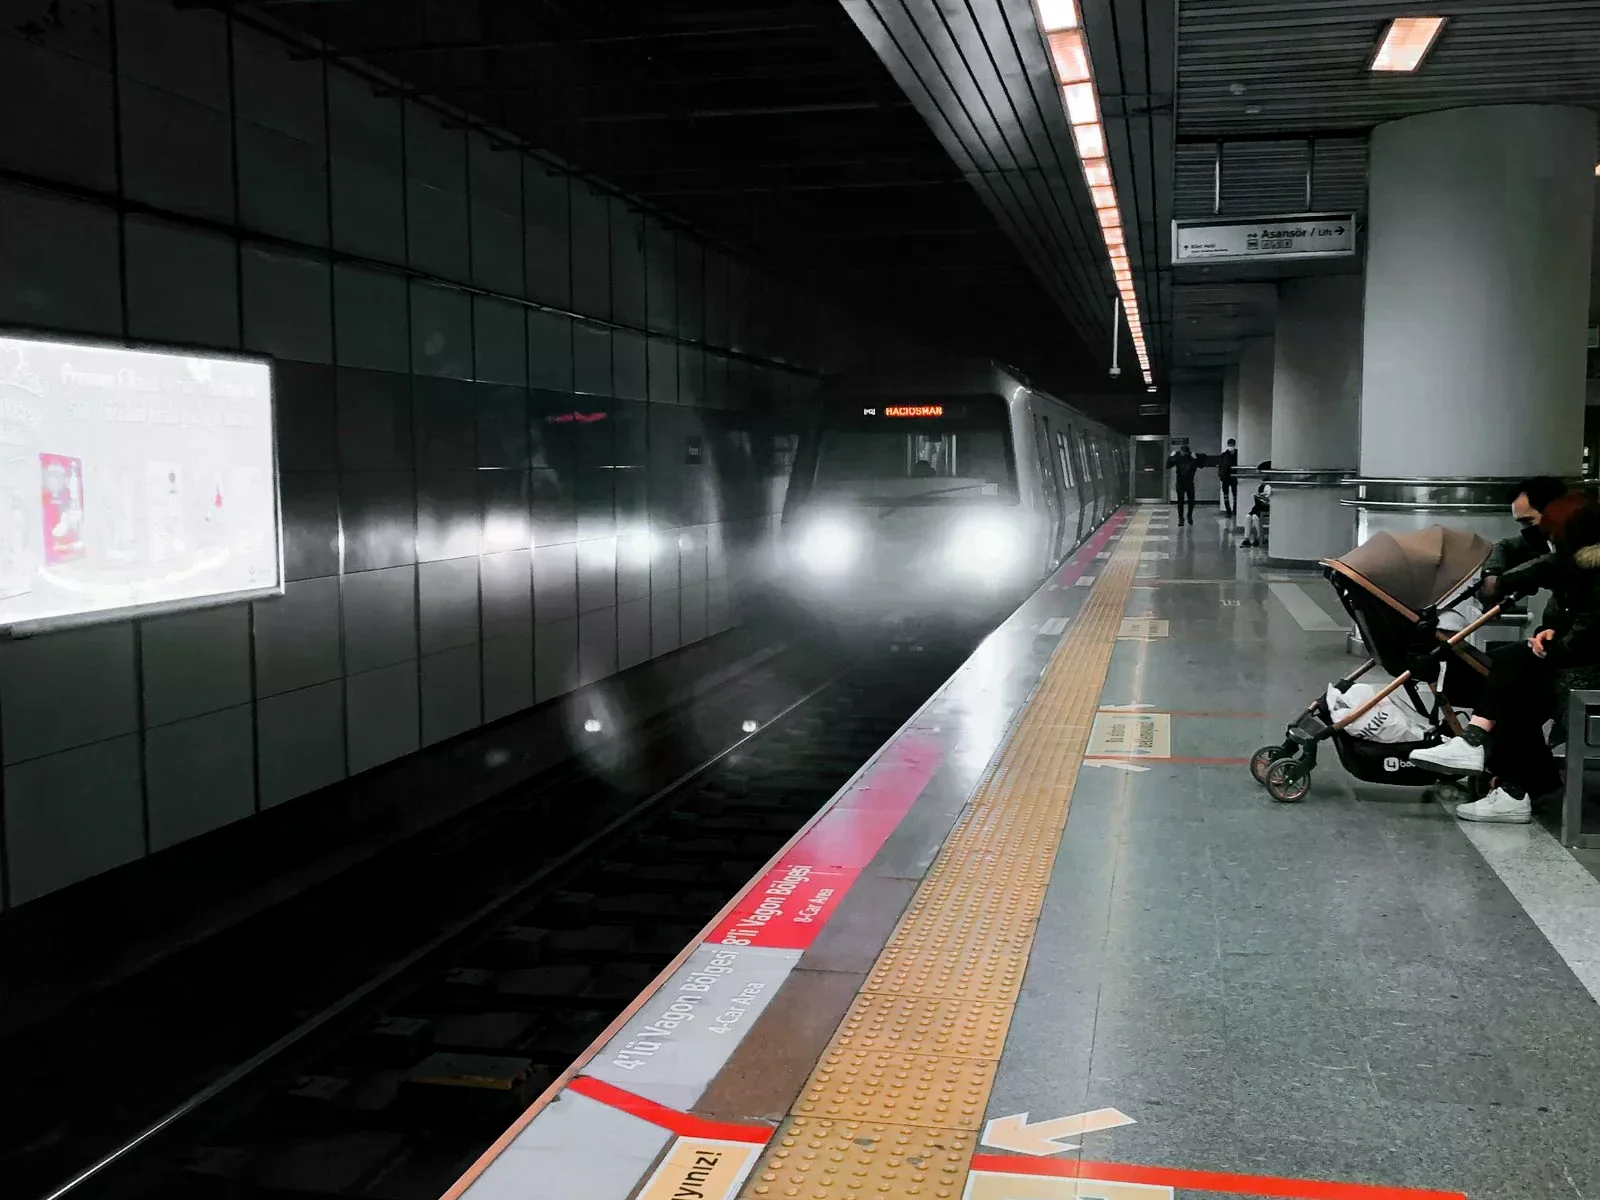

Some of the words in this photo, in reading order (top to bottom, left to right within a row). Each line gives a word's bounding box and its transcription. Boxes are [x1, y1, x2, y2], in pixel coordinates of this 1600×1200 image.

[1261, 228, 1306, 238] Asansör
[885, 407, 943, 416] HACIOSMAN
[736, 896, 787, 927] Vagon
[765, 864, 814, 896] Bölgesi
[792, 905, 823, 924] 8-Car
[808, 888, 836, 906] Area
[637, 994, 702, 1037] Vagon
[680, 949, 740, 992] Bölgesi
[707, 1007, 746, 1035] 4-Car
[731, 982, 766, 1007] Area
[671, 1151, 722, 1200] yınız!
